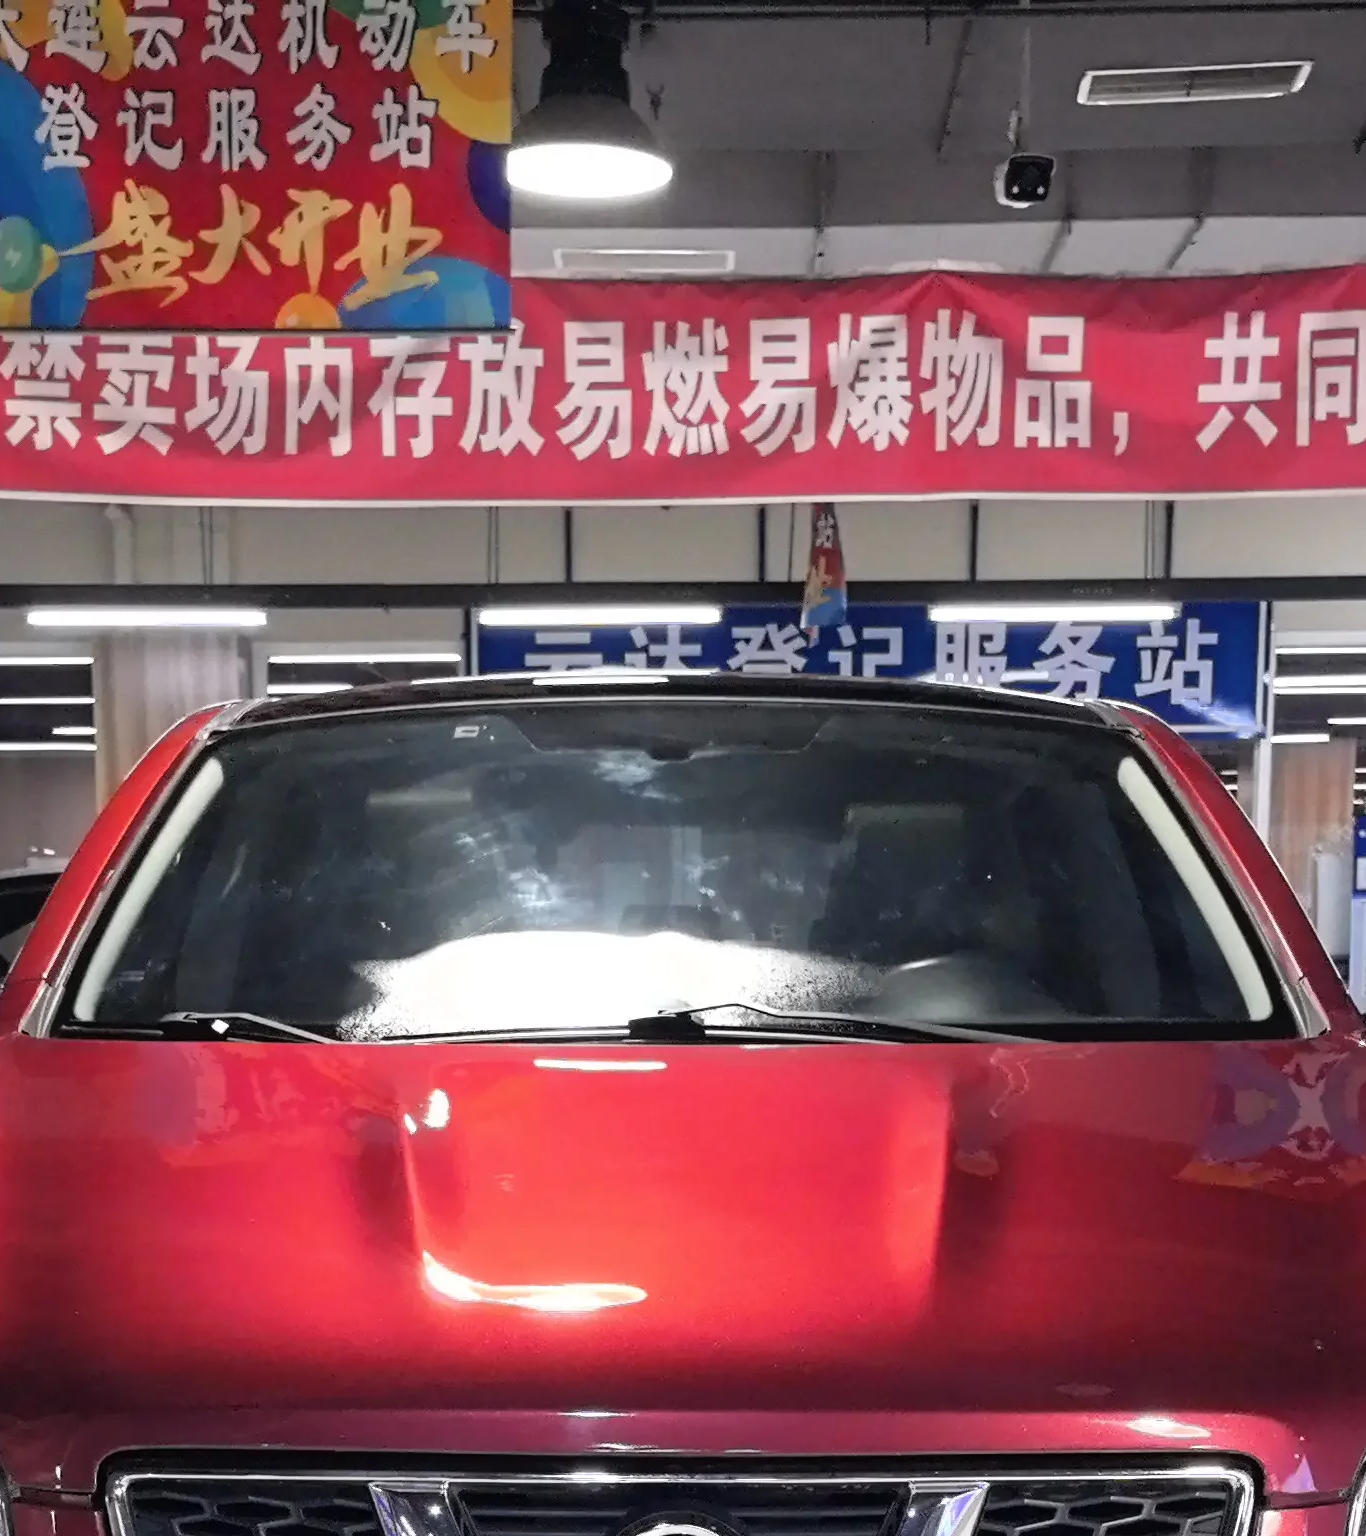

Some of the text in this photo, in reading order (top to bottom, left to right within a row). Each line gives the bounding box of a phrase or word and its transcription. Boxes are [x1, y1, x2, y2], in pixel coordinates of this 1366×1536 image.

[36, 82, 439, 172] 登记服务站
[55, 177, 443, 312] 盛大开业
